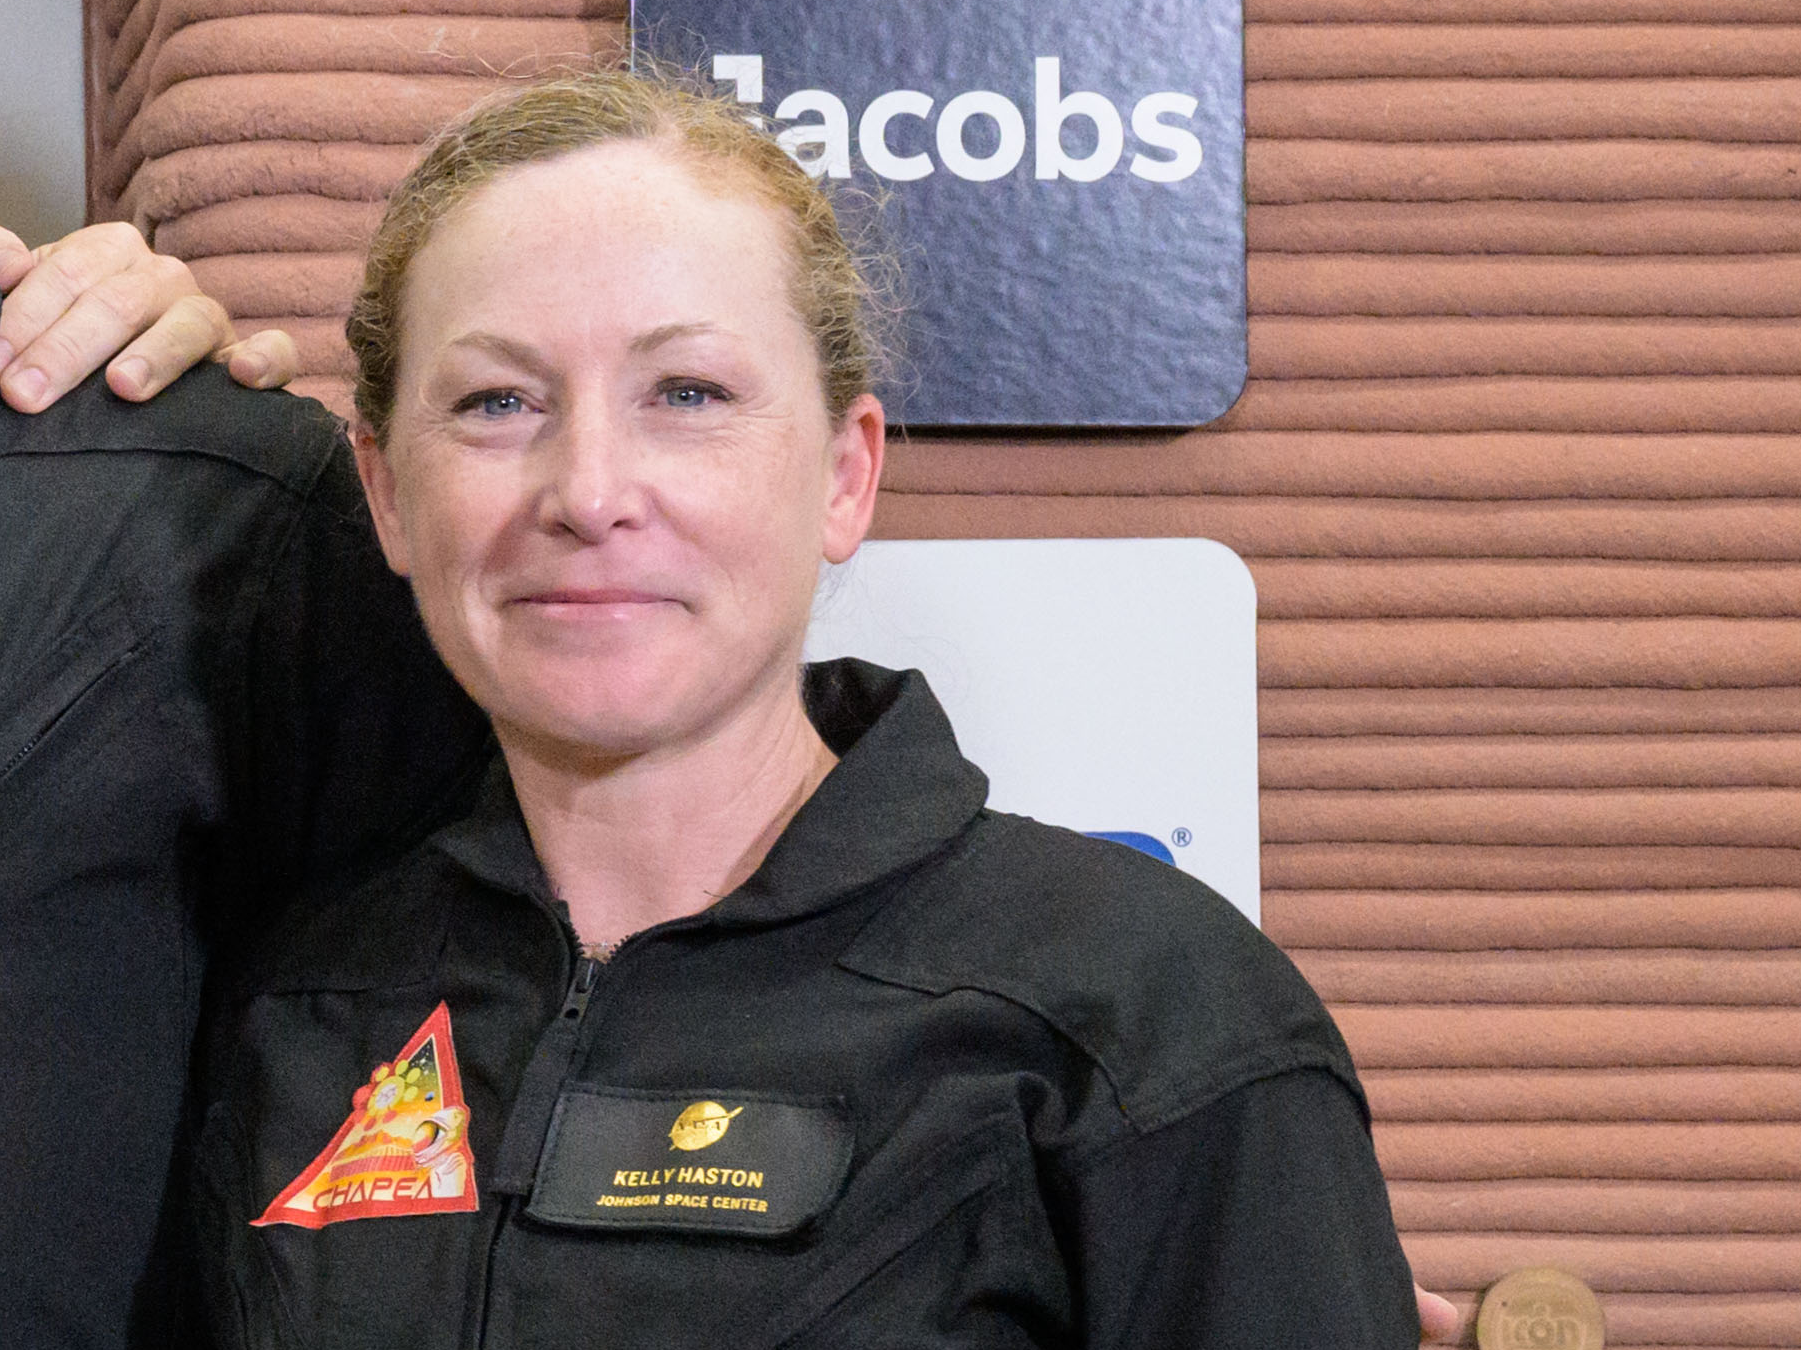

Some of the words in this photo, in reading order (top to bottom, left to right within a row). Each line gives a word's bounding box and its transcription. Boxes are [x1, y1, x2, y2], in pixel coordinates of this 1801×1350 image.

[613, 1168, 676, 1186] KELLY
[677, 1167, 764, 1188] HASTON
[312, 1175, 433, 1210] CHAPEA
[596, 1194, 660, 1207] JOHNSON
[664, 1193, 708, 1208] SPACE
[712, 1196, 768, 1213] CENTER
